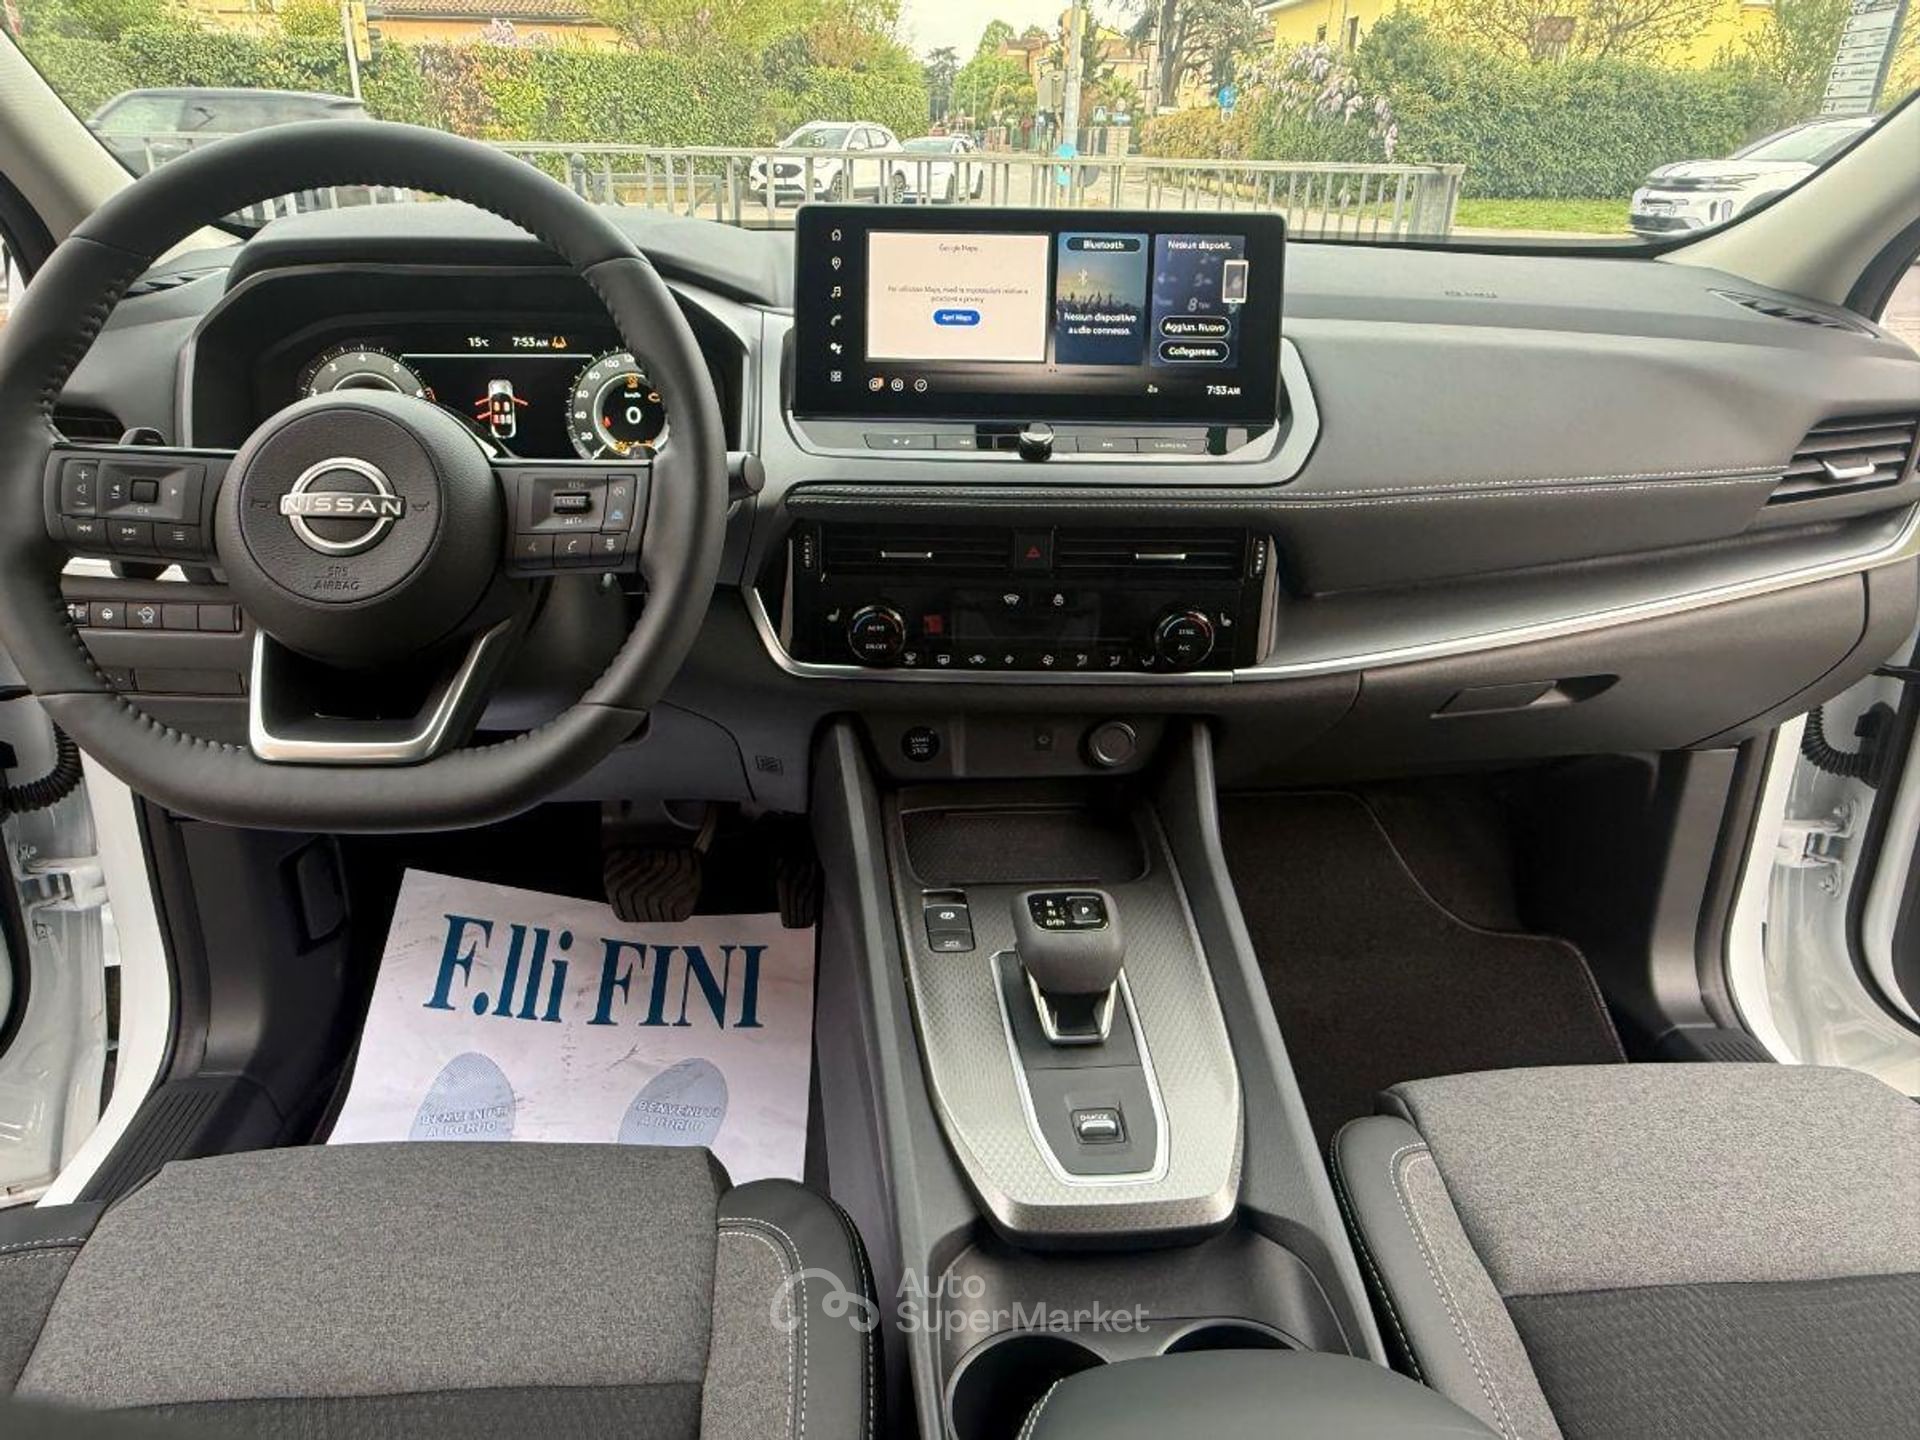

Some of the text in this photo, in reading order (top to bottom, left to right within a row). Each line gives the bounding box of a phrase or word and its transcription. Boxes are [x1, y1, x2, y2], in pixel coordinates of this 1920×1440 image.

[1083, 240, 1125, 250] Bluetooth
[511, 336, 535, 347] 7:53
[329, 363, 338, 372] 3
[392, 364, 401, 373] 5
[1206, 385, 1227, 395] 7:53
[625, 405, 642, 425] 0
[280, 494, 403, 517] NISSAN
[313, 580, 361, 591] AIRBAG
[587, 938, 768, 1030] FINI
